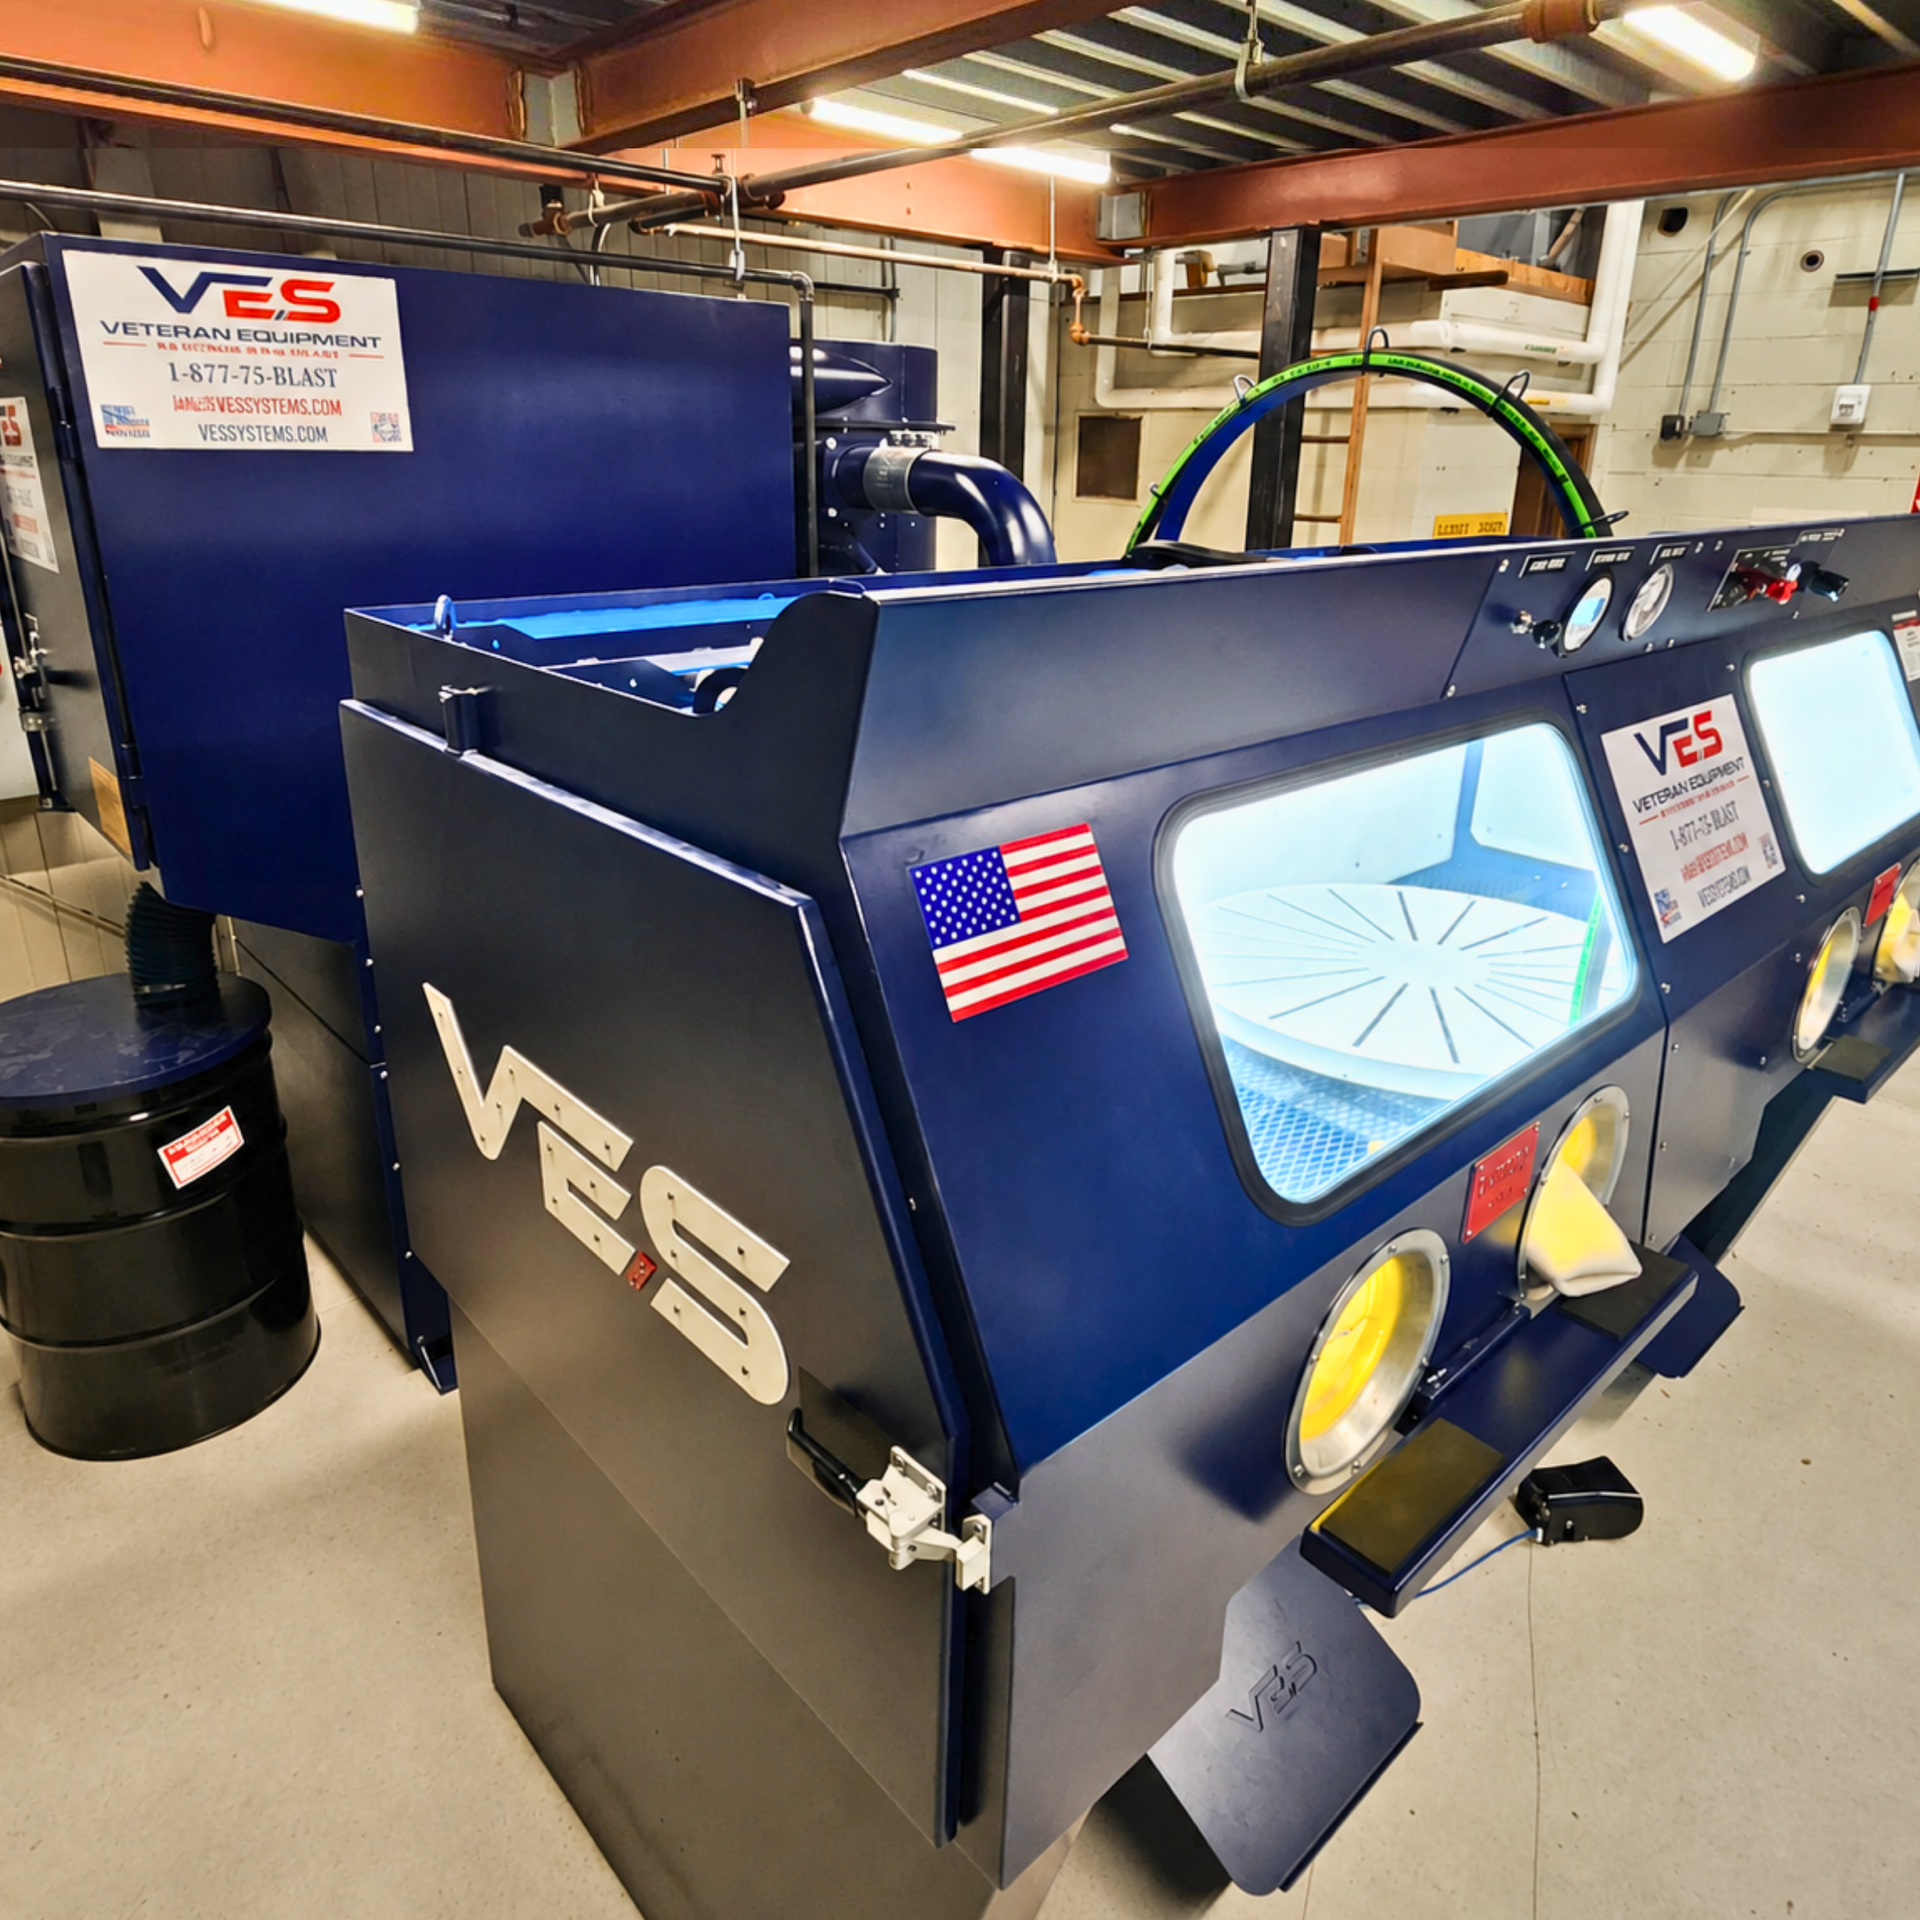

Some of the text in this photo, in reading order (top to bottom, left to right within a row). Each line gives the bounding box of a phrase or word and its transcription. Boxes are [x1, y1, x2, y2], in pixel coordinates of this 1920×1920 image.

[136, 266, 341, 323] VES
[100, 319, 381, 349] VETERAN EQUIPMENT
[167, 362, 337, 388] 1-877-75-BLAST
[198, 424, 328, 442] VESSYSTEMS.COM
[1634, 710, 1723, 776] VES
[1632, 780, 1689, 813] VETERAN
[422, 982, 790, 1405] VES
